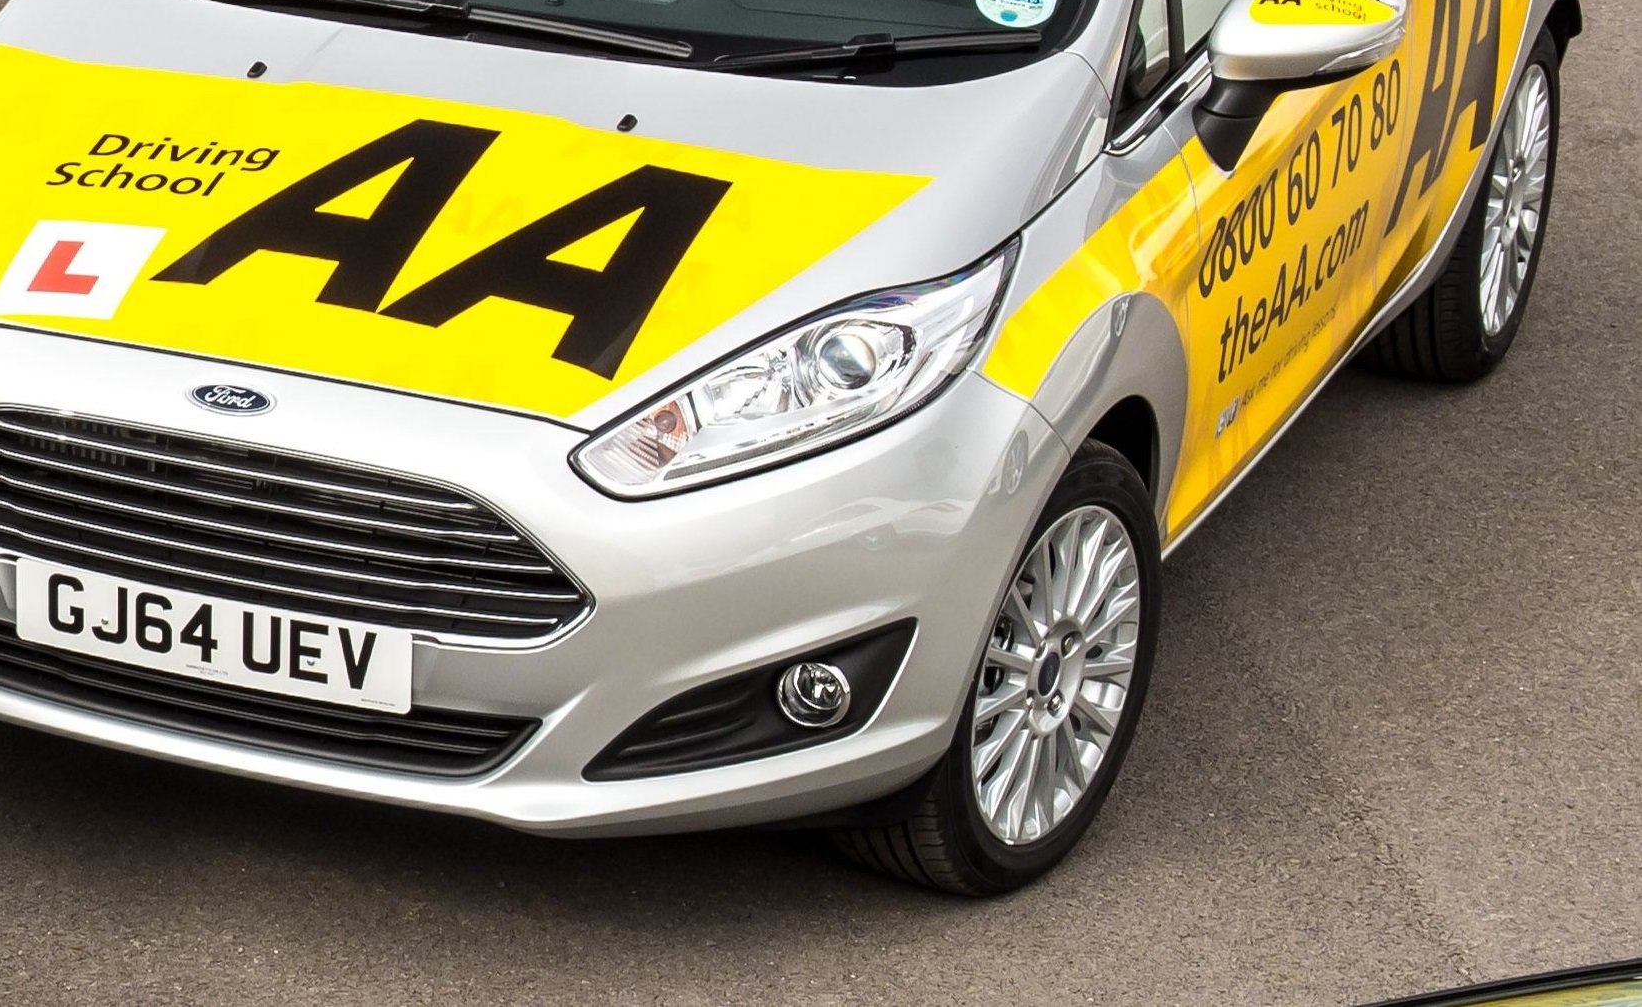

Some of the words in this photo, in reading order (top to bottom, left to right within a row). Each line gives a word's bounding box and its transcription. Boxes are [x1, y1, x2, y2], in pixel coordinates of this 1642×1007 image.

[1314, 1, 1367, 22] school
[45, 160, 226, 198] School
[87, 132, 282, 173] Driving
[1198, 167, 1279, 299] 0800
[1286, 128, 1321, 226] 60
[1331, 92, 1363, 190] 70
[1369, 58, 1401, 152] 80
[26, 239, 101, 296] L
[150, 117, 735, 382] AA
[1217, 198, 1370, 385] theAA.com
[203, 383, 264, 409] Ford
[47, 572, 218, 665] GJ64
[241, 610, 378, 692] UEV
